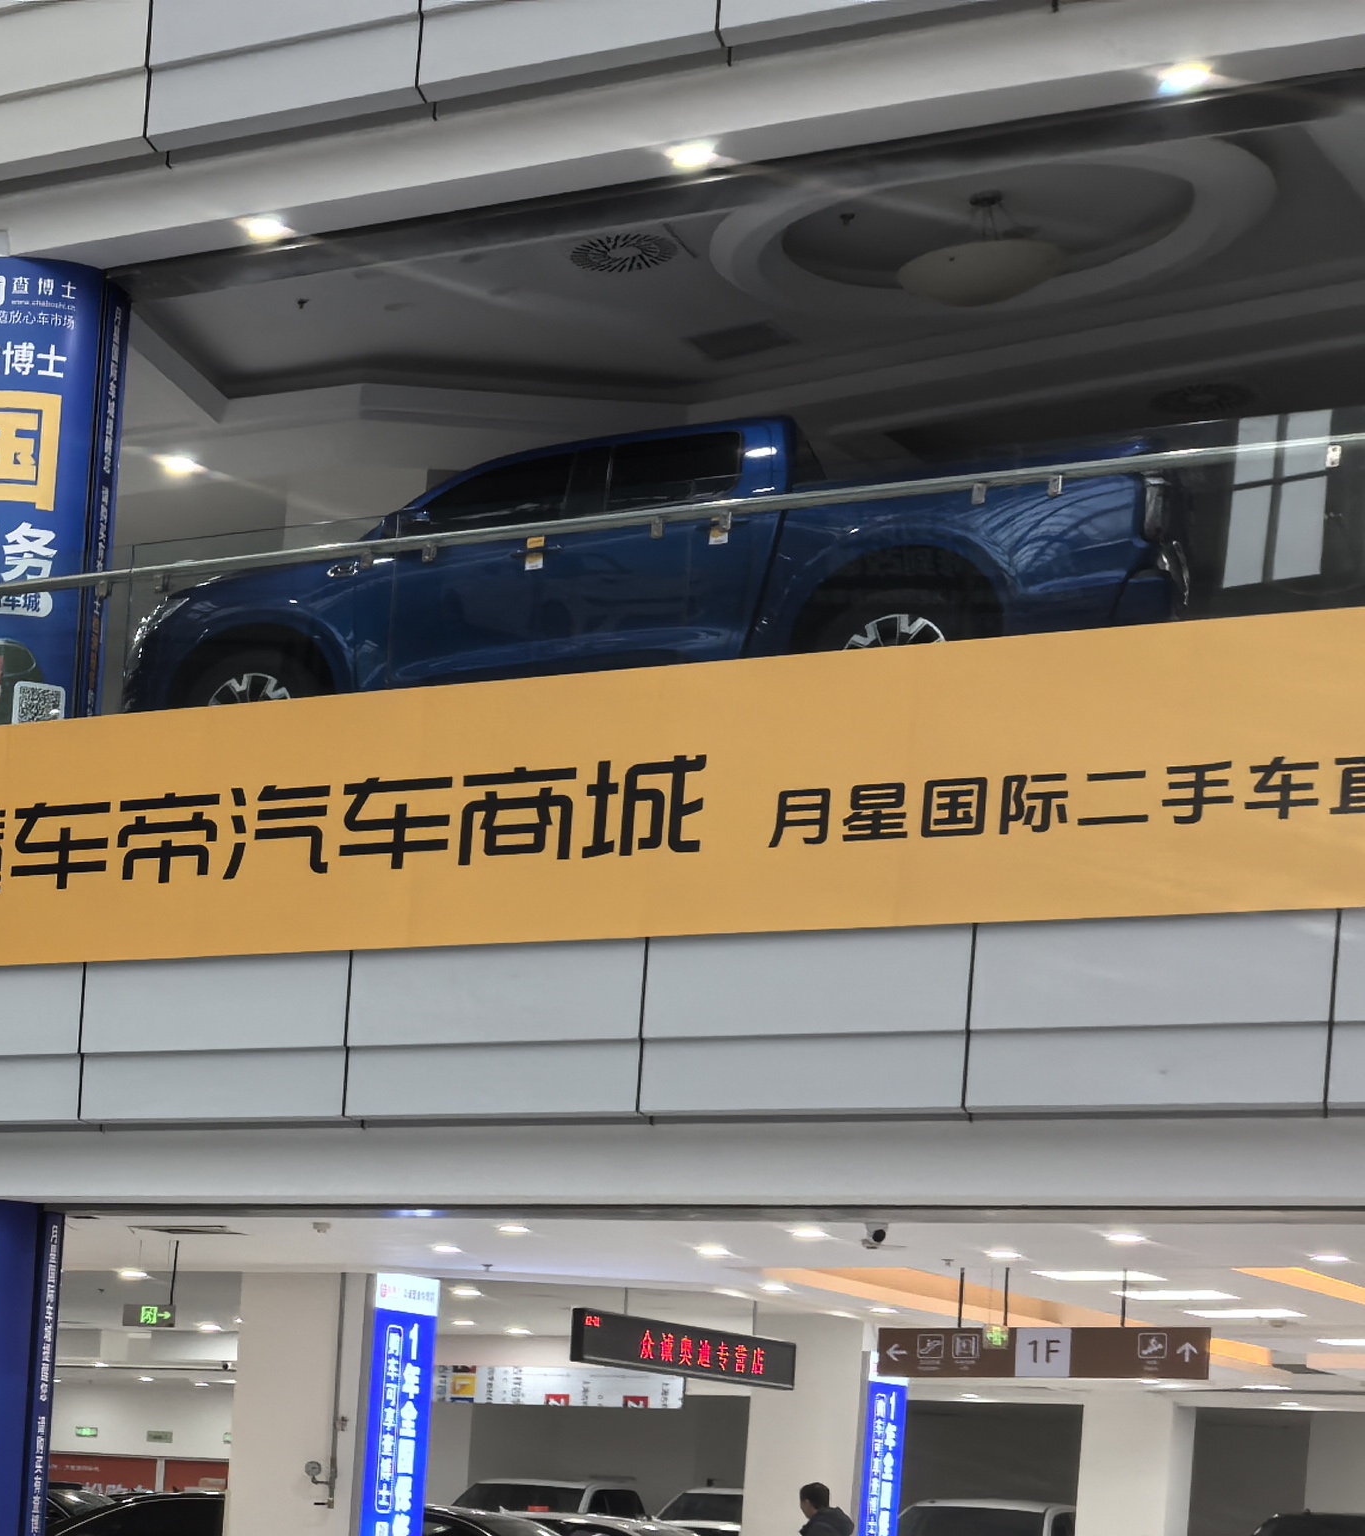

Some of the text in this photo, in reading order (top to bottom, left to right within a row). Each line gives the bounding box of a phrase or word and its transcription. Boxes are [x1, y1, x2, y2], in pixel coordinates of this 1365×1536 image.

[11, 276, 77, 299] 查博士
[1027, 1338, 1062, 1364] 1F
